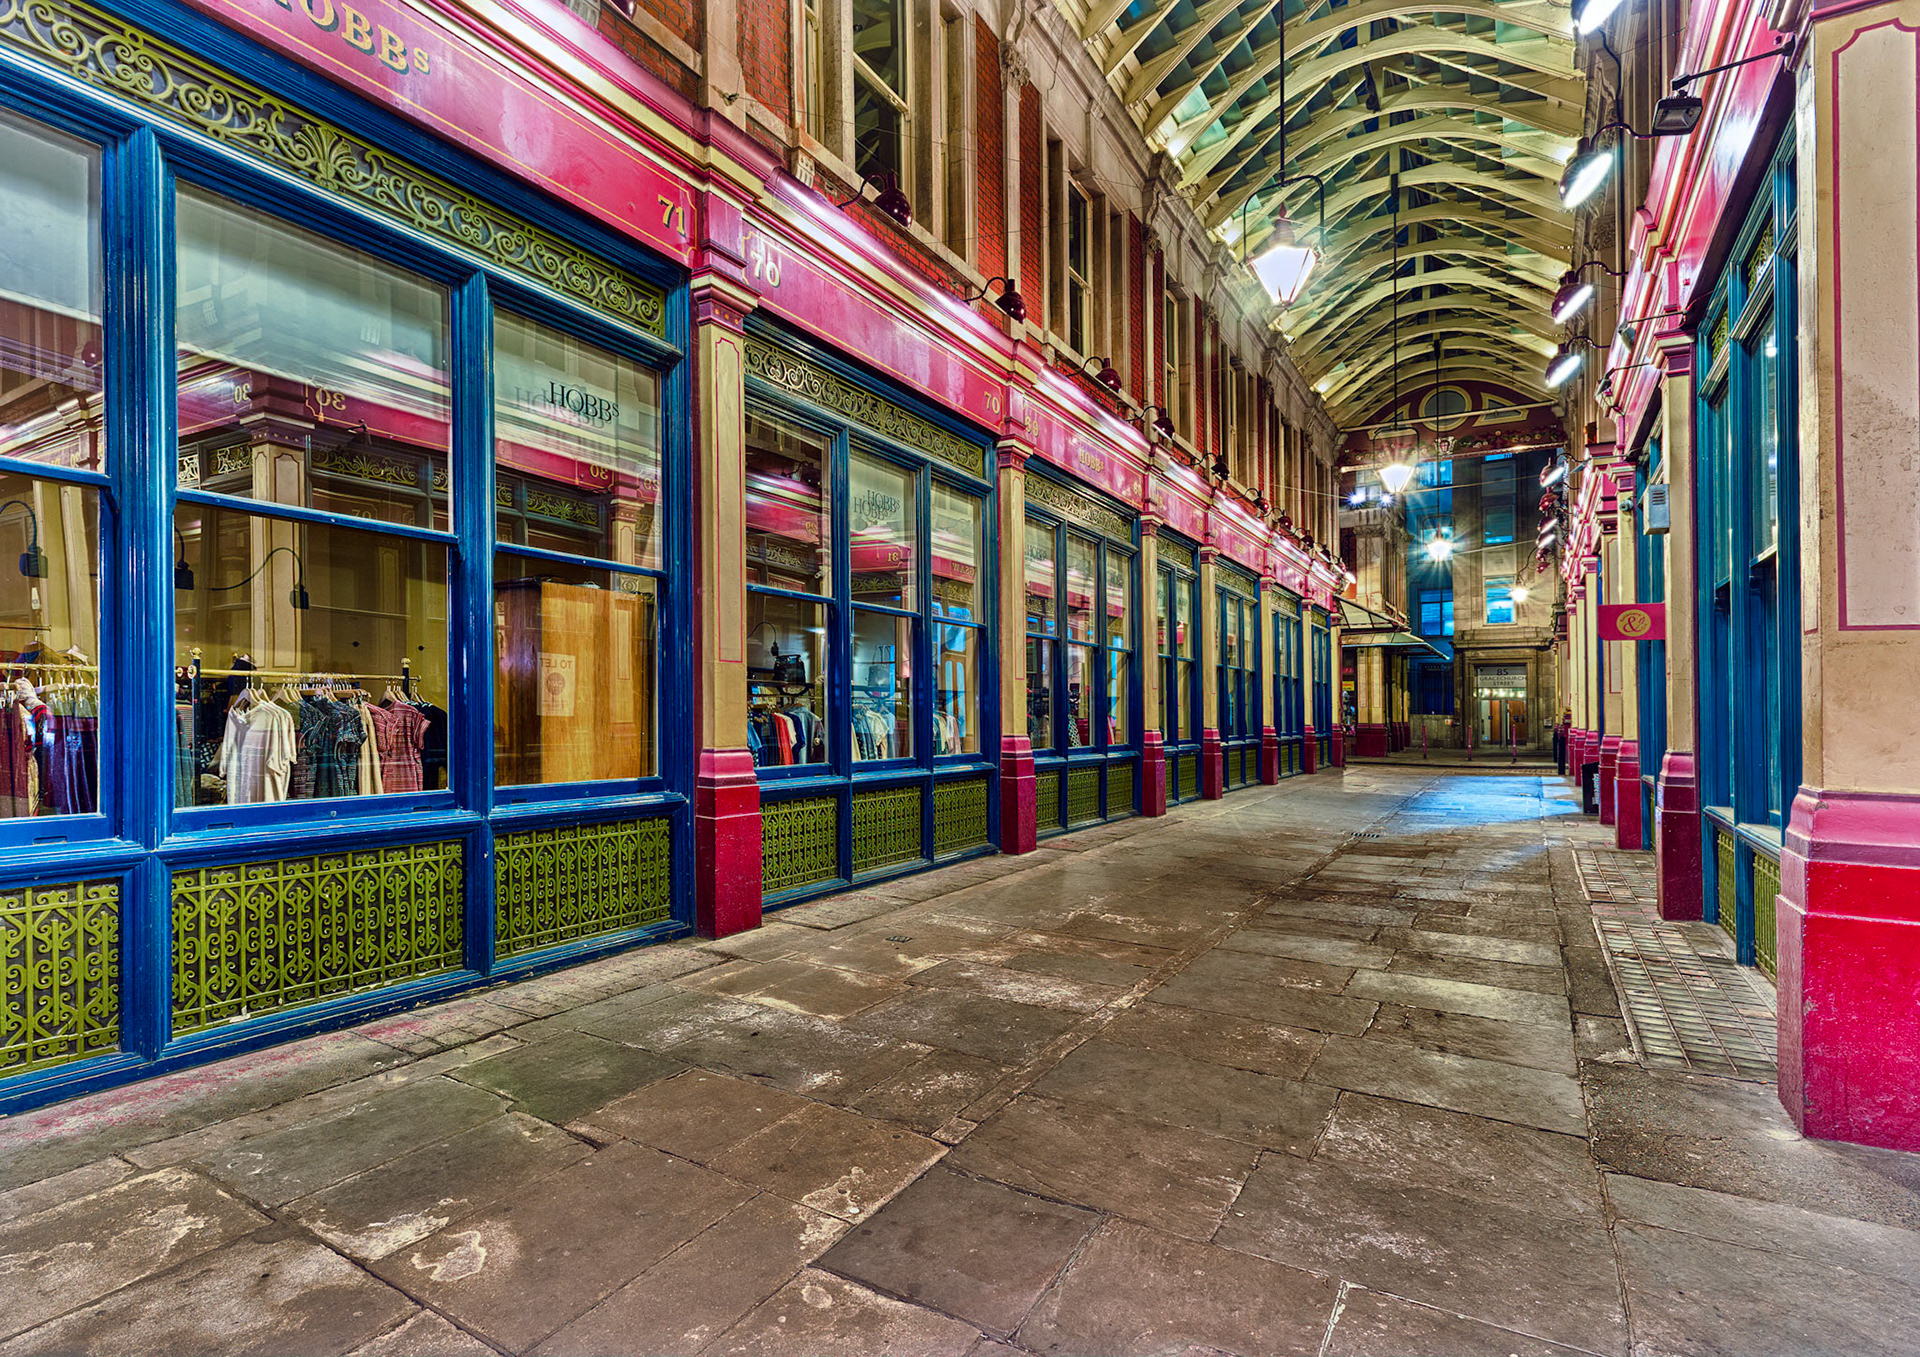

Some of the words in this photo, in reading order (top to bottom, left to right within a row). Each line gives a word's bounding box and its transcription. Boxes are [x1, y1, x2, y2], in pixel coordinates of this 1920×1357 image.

[658, 194, 686, 238] 71
[751, 250, 780, 288] 70
[984, 391, 1000, 415] 70
